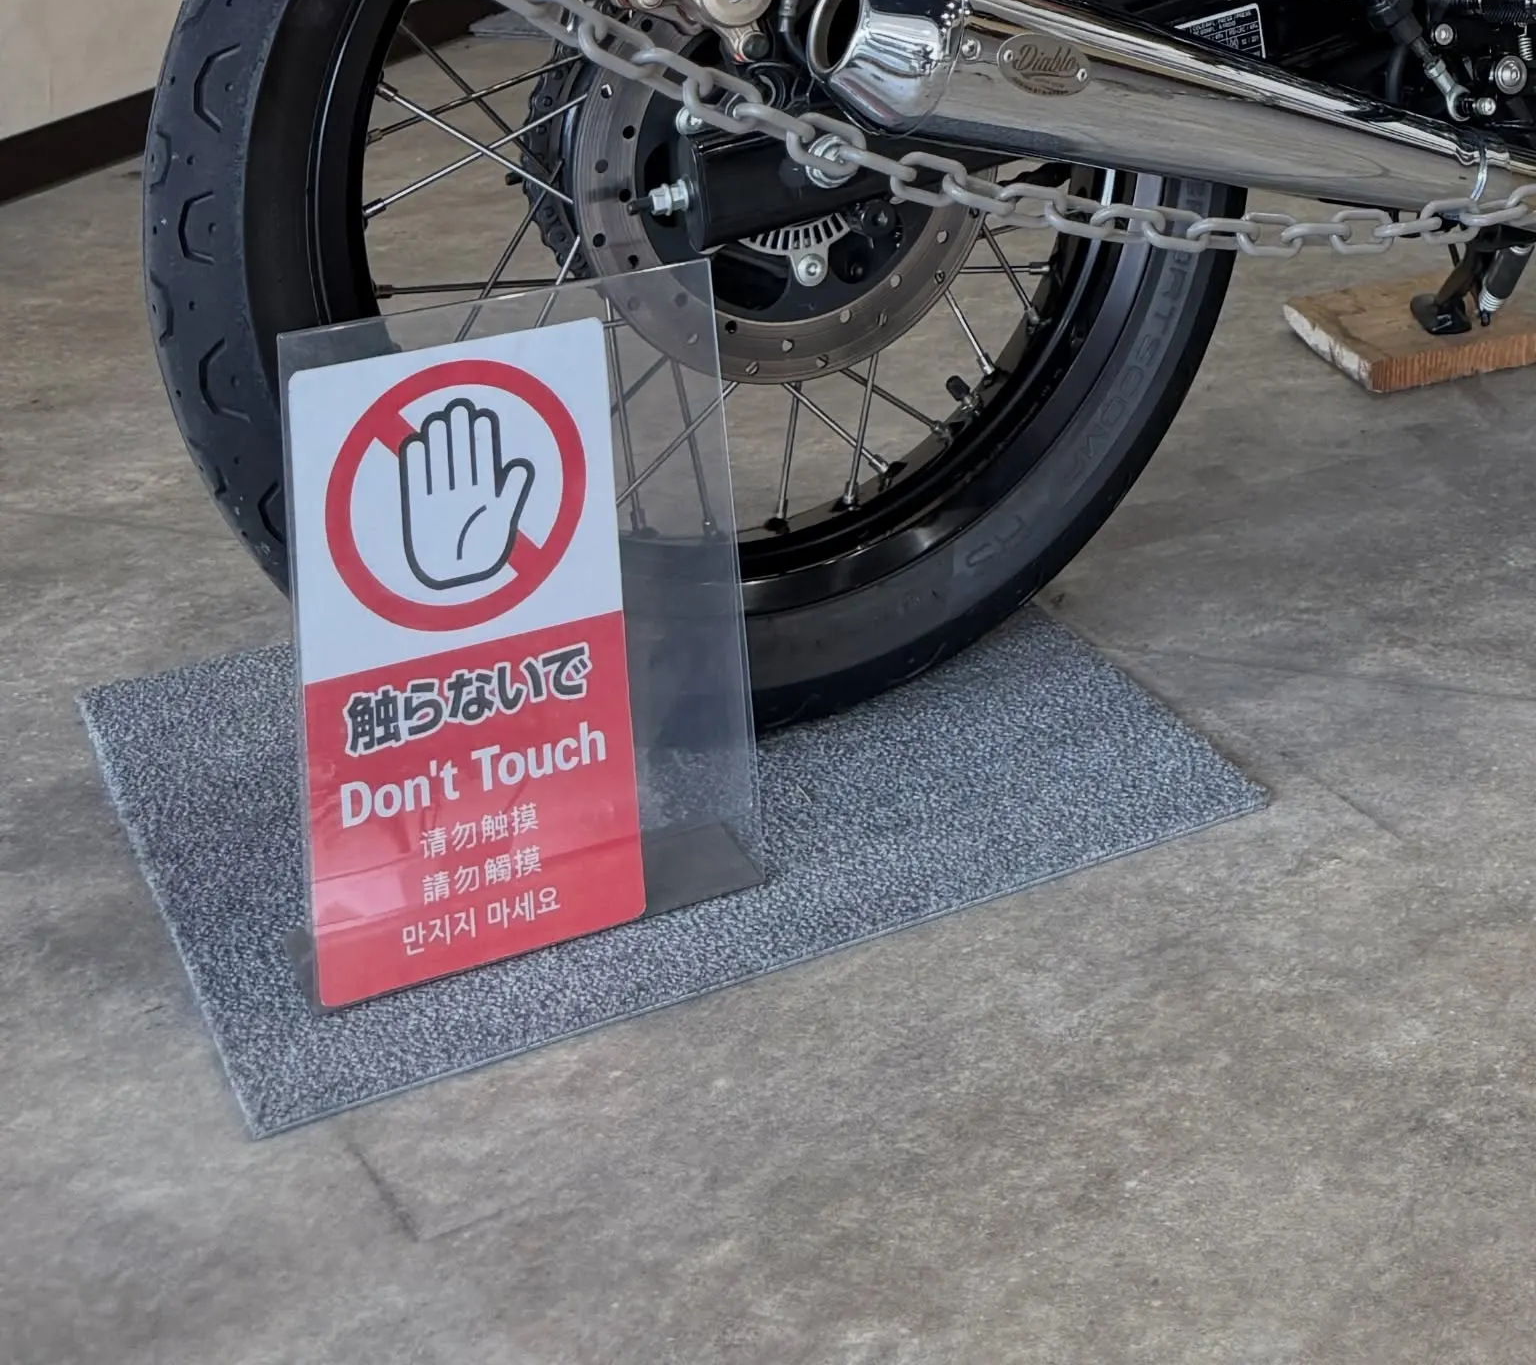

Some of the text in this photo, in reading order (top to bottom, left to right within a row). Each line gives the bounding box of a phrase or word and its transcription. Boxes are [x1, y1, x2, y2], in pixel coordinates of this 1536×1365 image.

[1012, 43, 1080, 75] Diablo
[342, 642, 590, 757] 触らないで
[339, 722, 607, 829] Don't Touch
[419, 803, 538, 860] 请勿触摸
[422, 846, 543, 905] 請勿觸摸
[401, 885, 562, 956] 만지지 마세요
